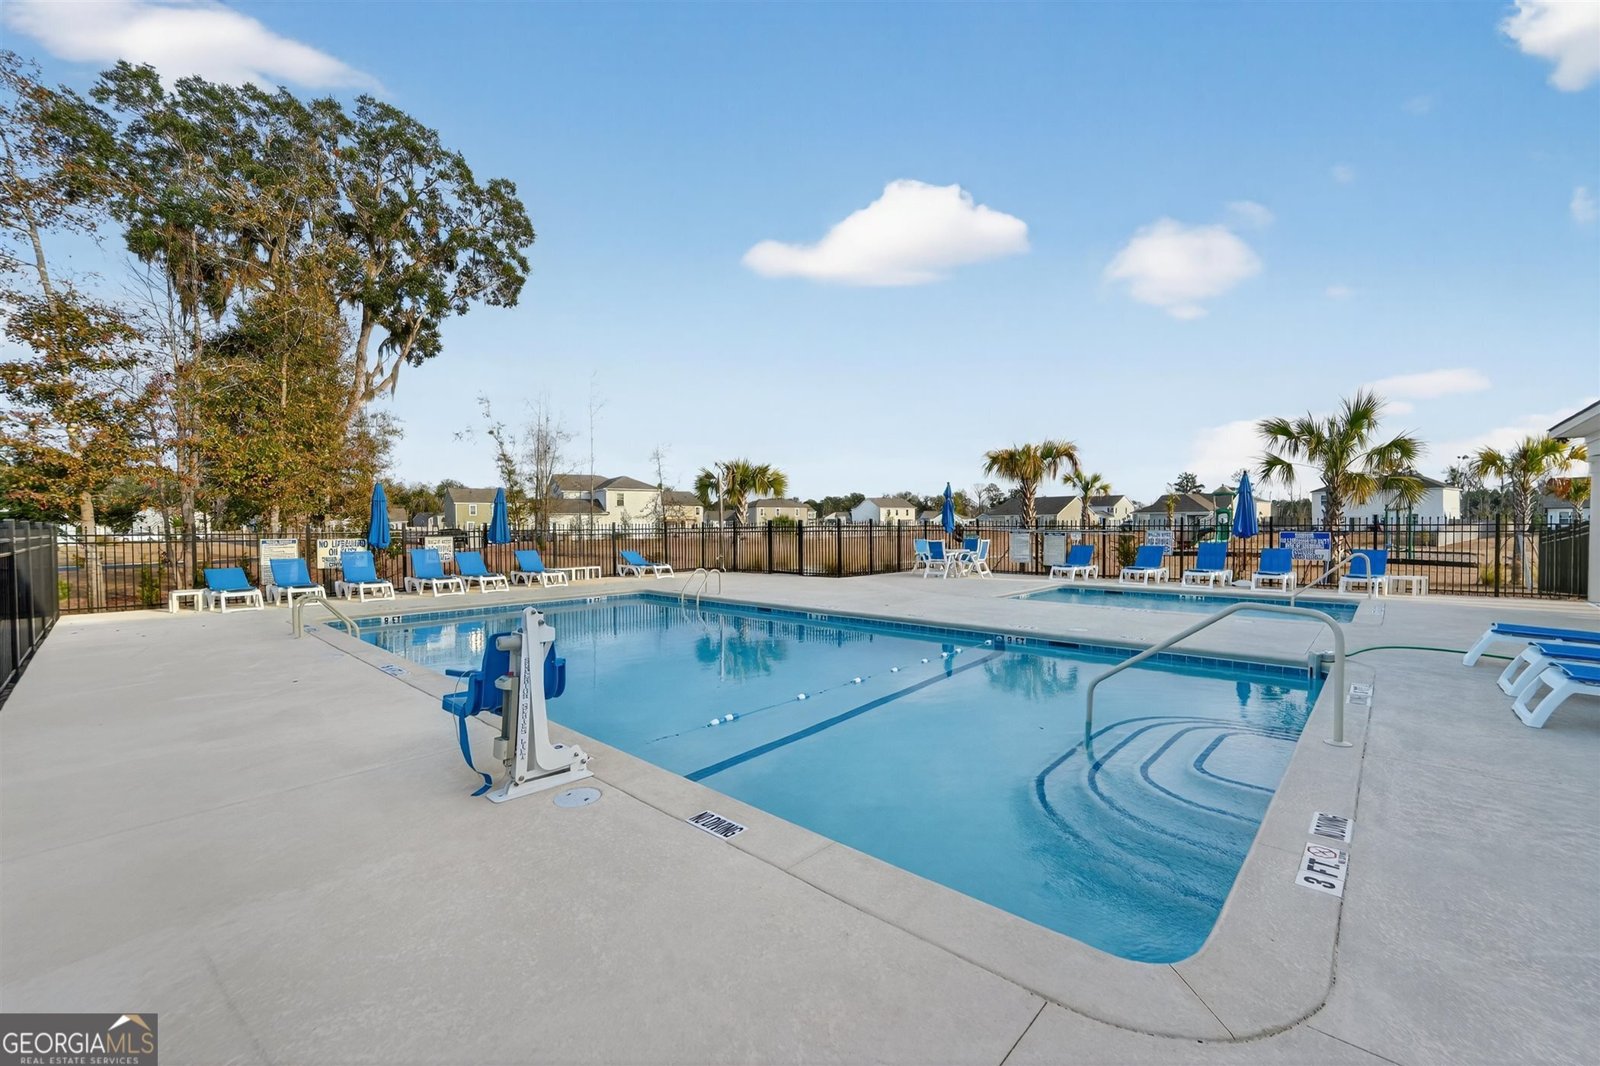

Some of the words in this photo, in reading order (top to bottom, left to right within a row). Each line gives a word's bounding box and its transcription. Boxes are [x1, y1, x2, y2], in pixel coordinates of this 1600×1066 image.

[319, 540, 329, 548] NO
[689, 811, 715, 823] NO
[701, 817, 744, 838] DIVING
[1303, 876, 1336, 889] 3
